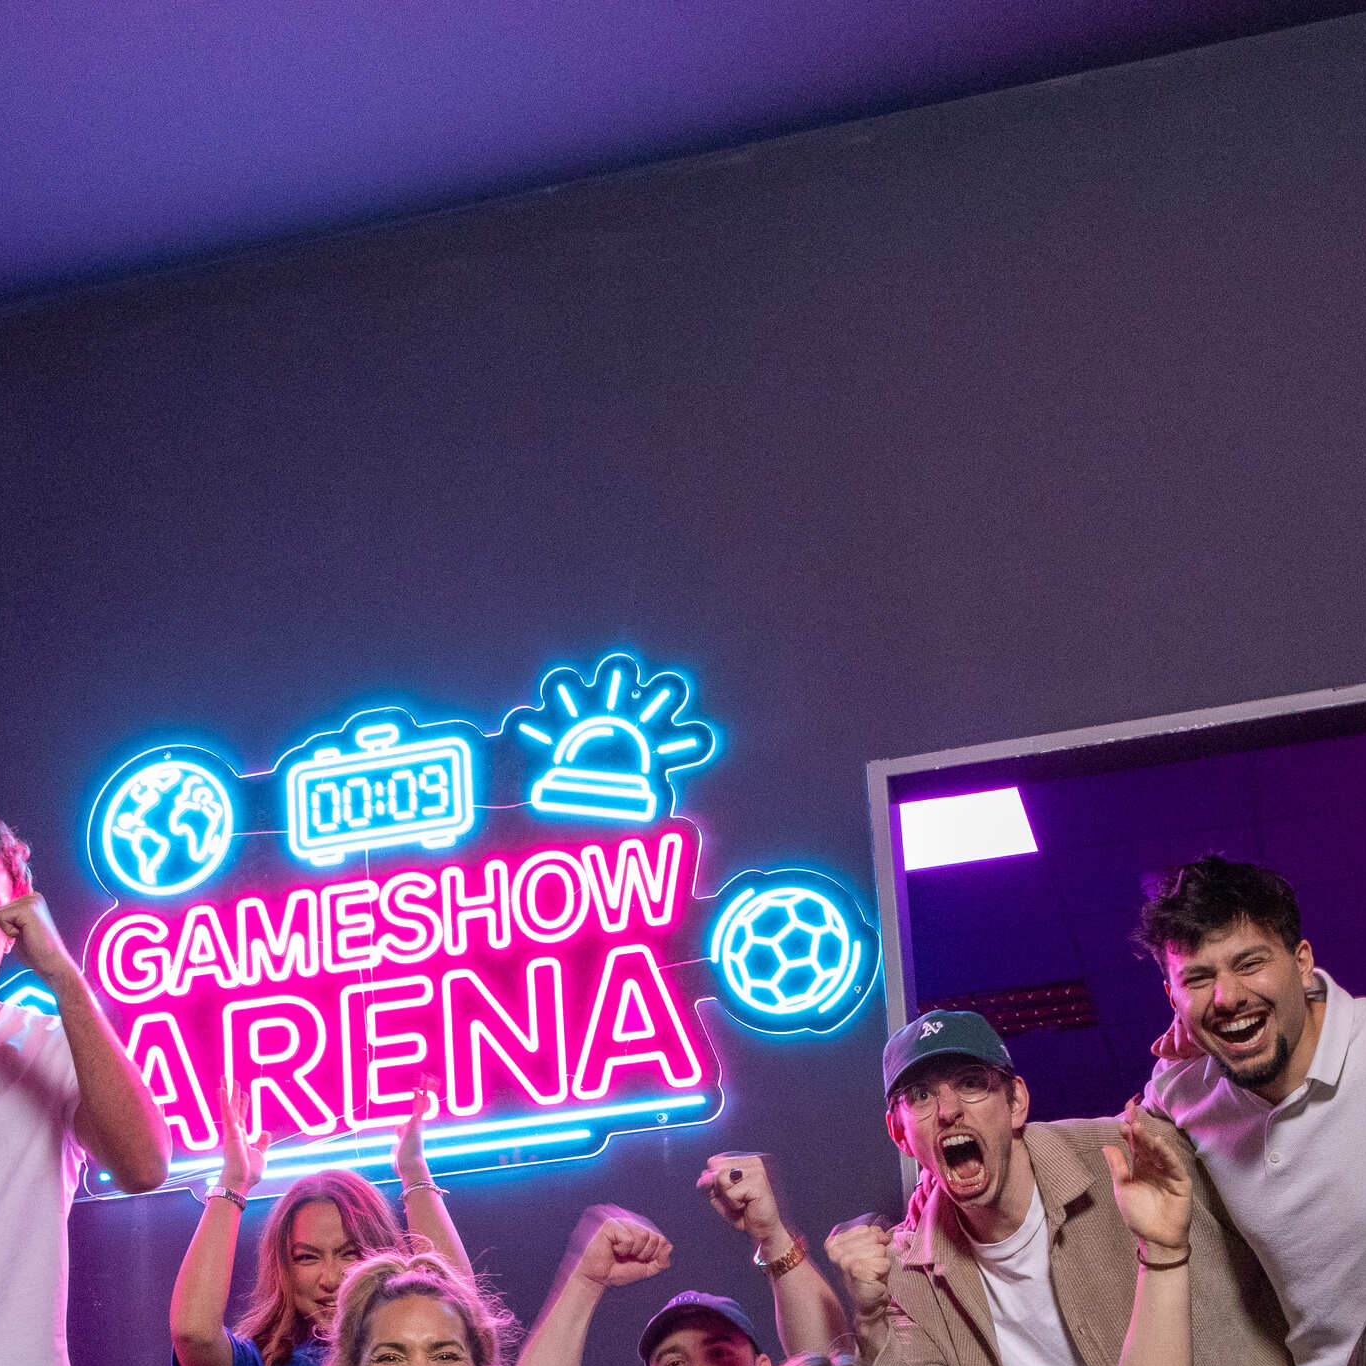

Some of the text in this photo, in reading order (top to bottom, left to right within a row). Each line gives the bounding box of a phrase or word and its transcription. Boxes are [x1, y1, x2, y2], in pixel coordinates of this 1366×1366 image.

[311, 765, 449, 832] 00:09
[98, 831, 683, 1004] GAMESHOW
[125, 944, 703, 1151] ARENA
